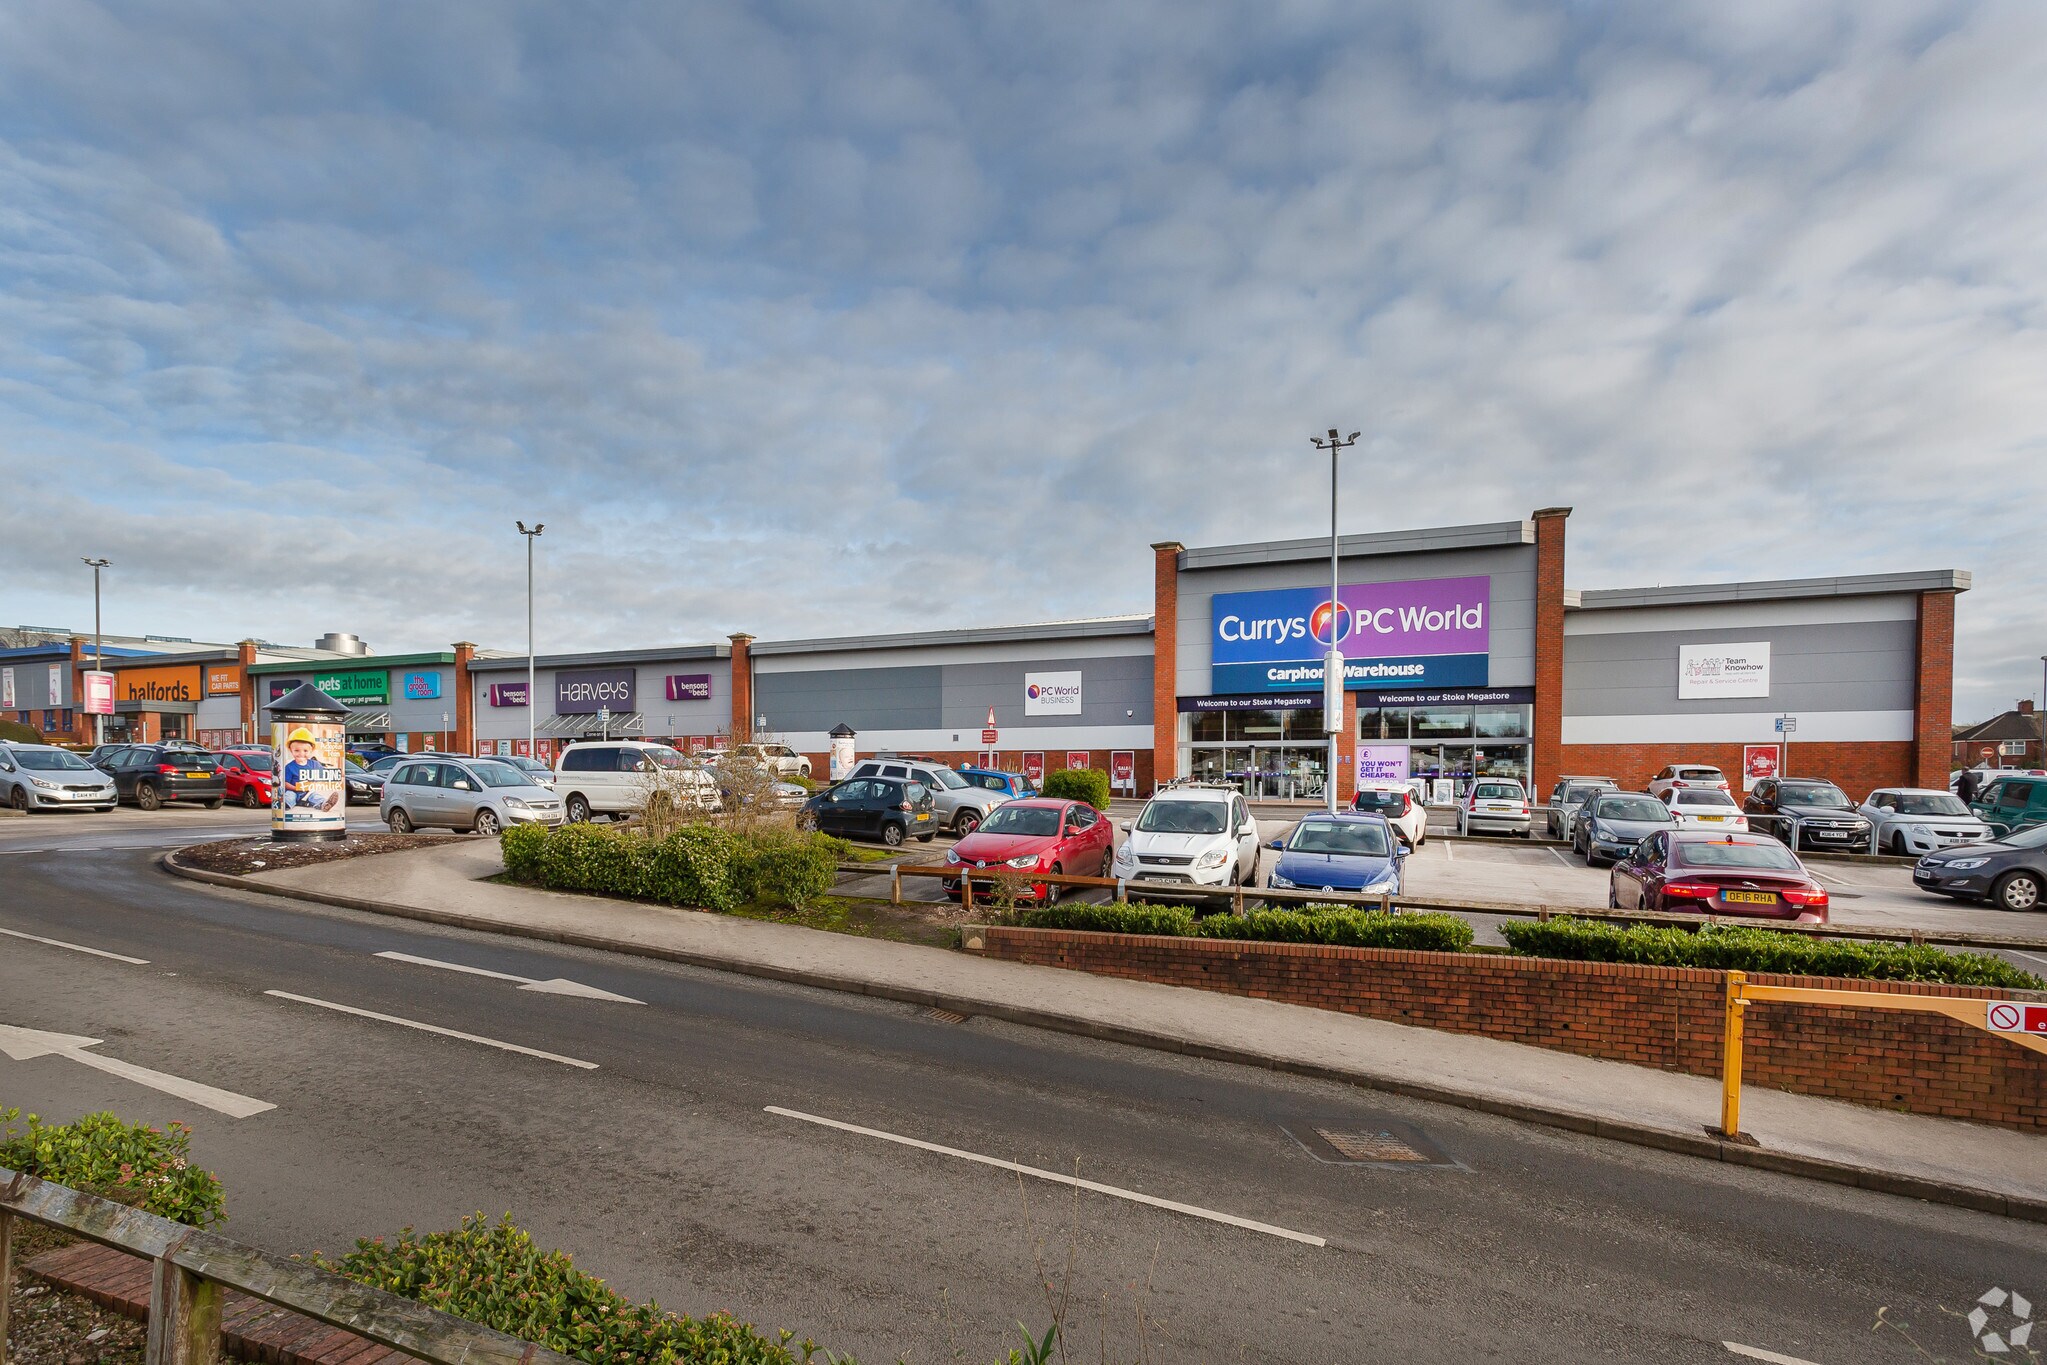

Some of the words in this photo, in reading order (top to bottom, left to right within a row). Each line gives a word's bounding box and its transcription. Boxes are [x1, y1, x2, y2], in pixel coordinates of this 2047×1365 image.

[1355, 608, 1395, 635] PC
[1398, 602, 1483, 632] World
[1219, 615, 1306, 644] Currys
[211, 674, 219, 682] WE
[1267, 666, 1325, 683] Carphon
[318, 676, 341, 691] pets
[342, 676, 353, 690] at
[354, 674, 383, 690] home
[681, 682, 708, 690] bensons
[128, 680, 190, 701] halfords
[503, 690, 526, 698] bensons
[1041, 686, 1053, 696] PC
[1054, 685, 1080, 696] World
[1041, 696, 1075, 704] BUSINESS
[1197, 699, 1229, 707] Welcome
[1273, 698, 1312, 707] Megastore
[1379, 694, 1415, 702] Welcome
[1467, 692, 1509, 702] Megastore
[300, 769, 342, 781] BUILDING
[299, 780, 343, 792] Families
[1729, 892, 1752, 902] OE16
[1753, 893, 1773, 903] RHA
